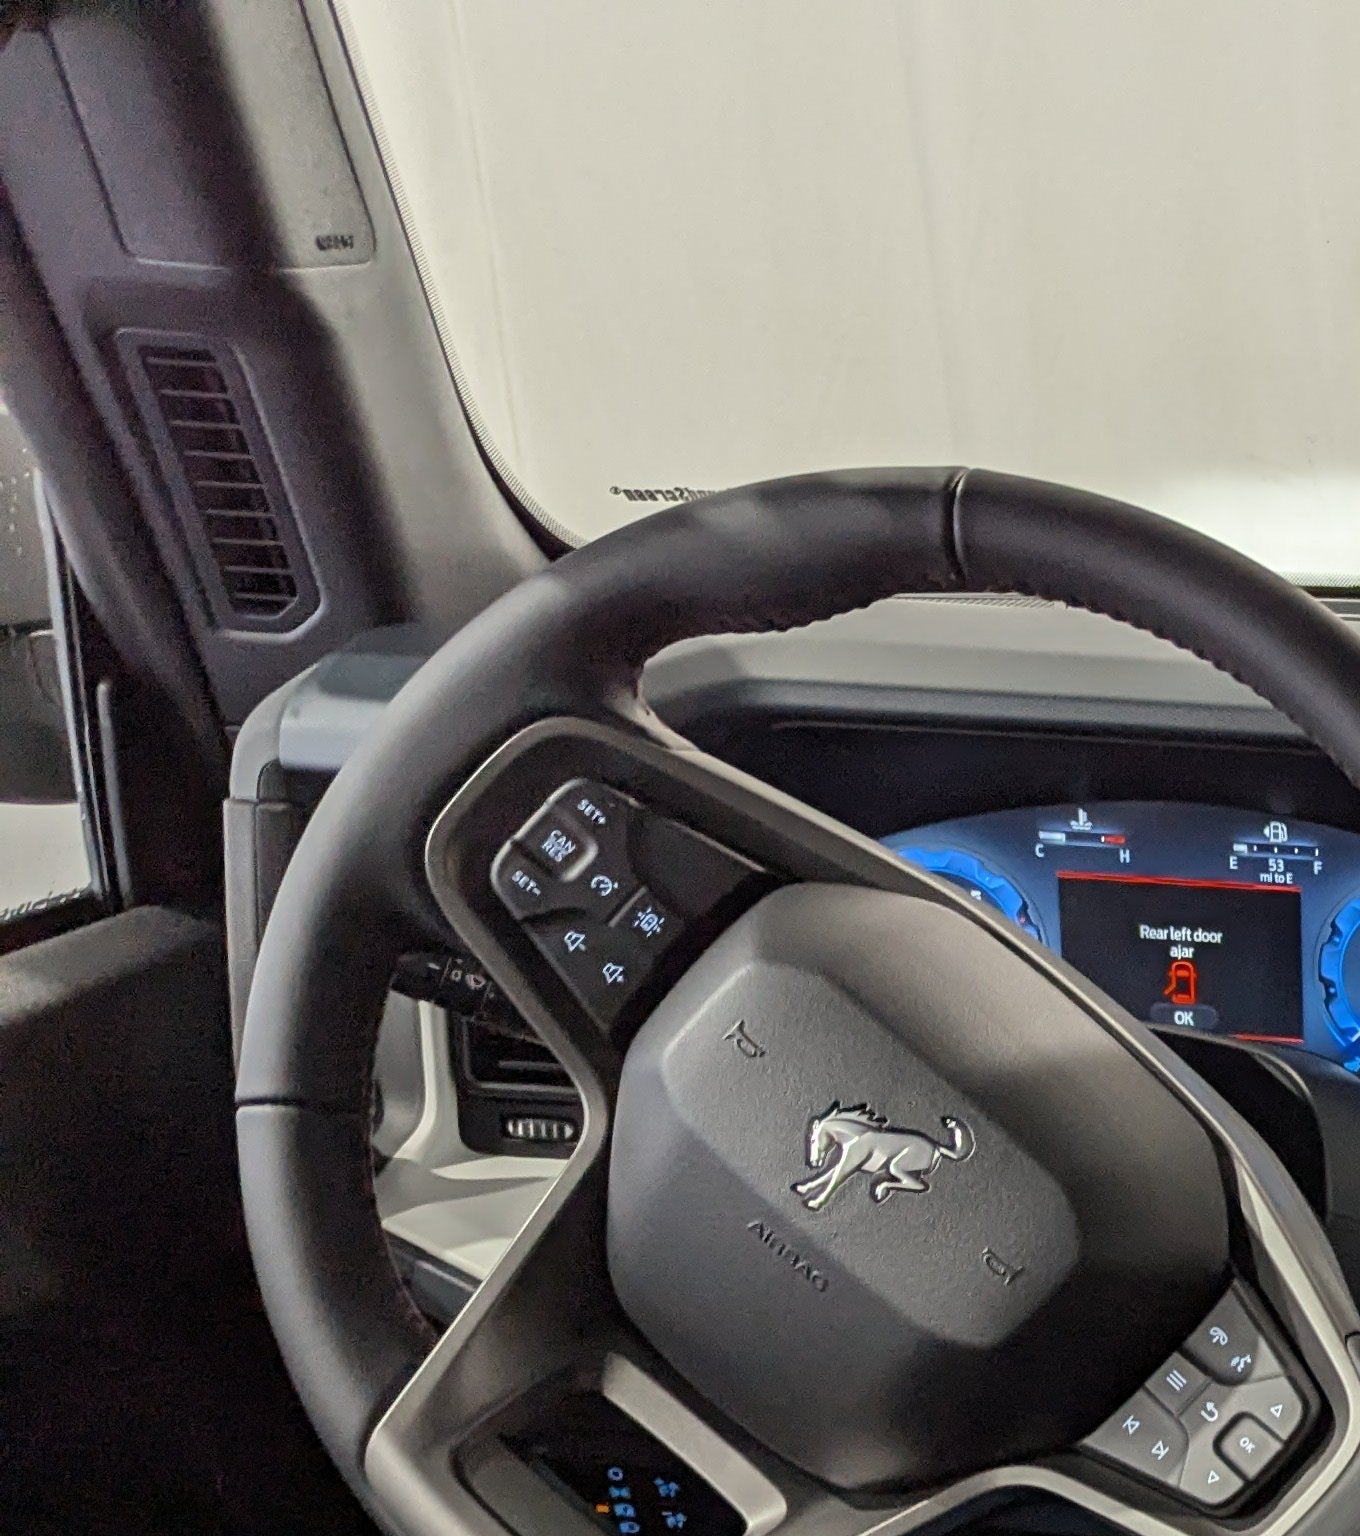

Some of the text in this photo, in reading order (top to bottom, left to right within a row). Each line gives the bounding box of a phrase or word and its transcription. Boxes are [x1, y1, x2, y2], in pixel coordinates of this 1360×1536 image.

[550, 829, 576, 853] CAN
[1035, 845, 1044, 858] C
[1120, 850, 1130, 864] H
[1229, 856, 1238, 870] E
[1268, 859, 1285, 872] 53
[1314, 861, 1322, 875] F
[1260, 872, 1293, 885] mi to E
[1139, 925, 1222, 944] Rear left door
[1170, 945, 1194, 960] ajar
[1174, 1011, 1194, 1026] OK
[1239, 1437, 1256, 1454] OK
